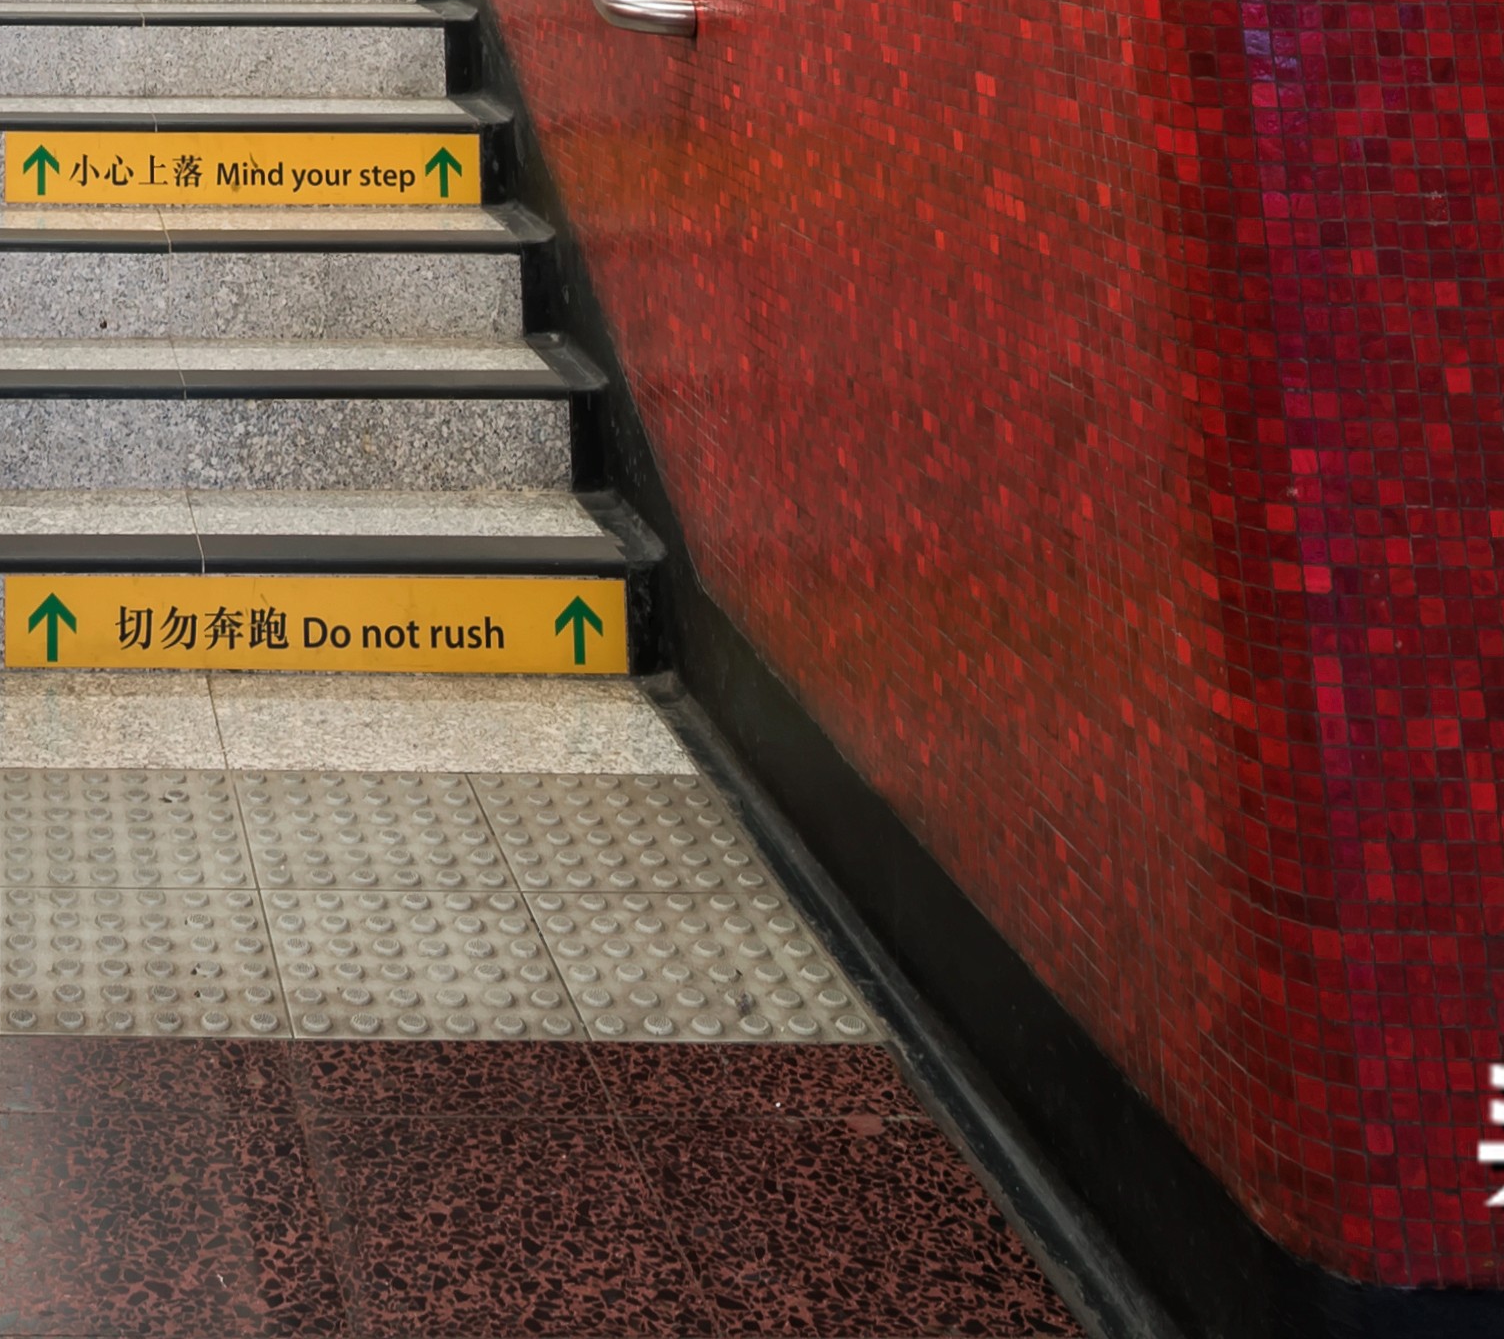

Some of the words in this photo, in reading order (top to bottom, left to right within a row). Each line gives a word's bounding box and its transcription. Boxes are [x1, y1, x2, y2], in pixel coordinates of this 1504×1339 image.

[69, 154, 203, 189] 小心上落
[217, 161, 284, 186] Mind
[290, 169, 352, 193] your
[359, 165, 416, 193] step
[116, 605, 290, 651] 切勿奔跑
[303, 617, 351, 649] Do
[362, 620, 420, 649] not
[430, 616, 505, 649] rush
